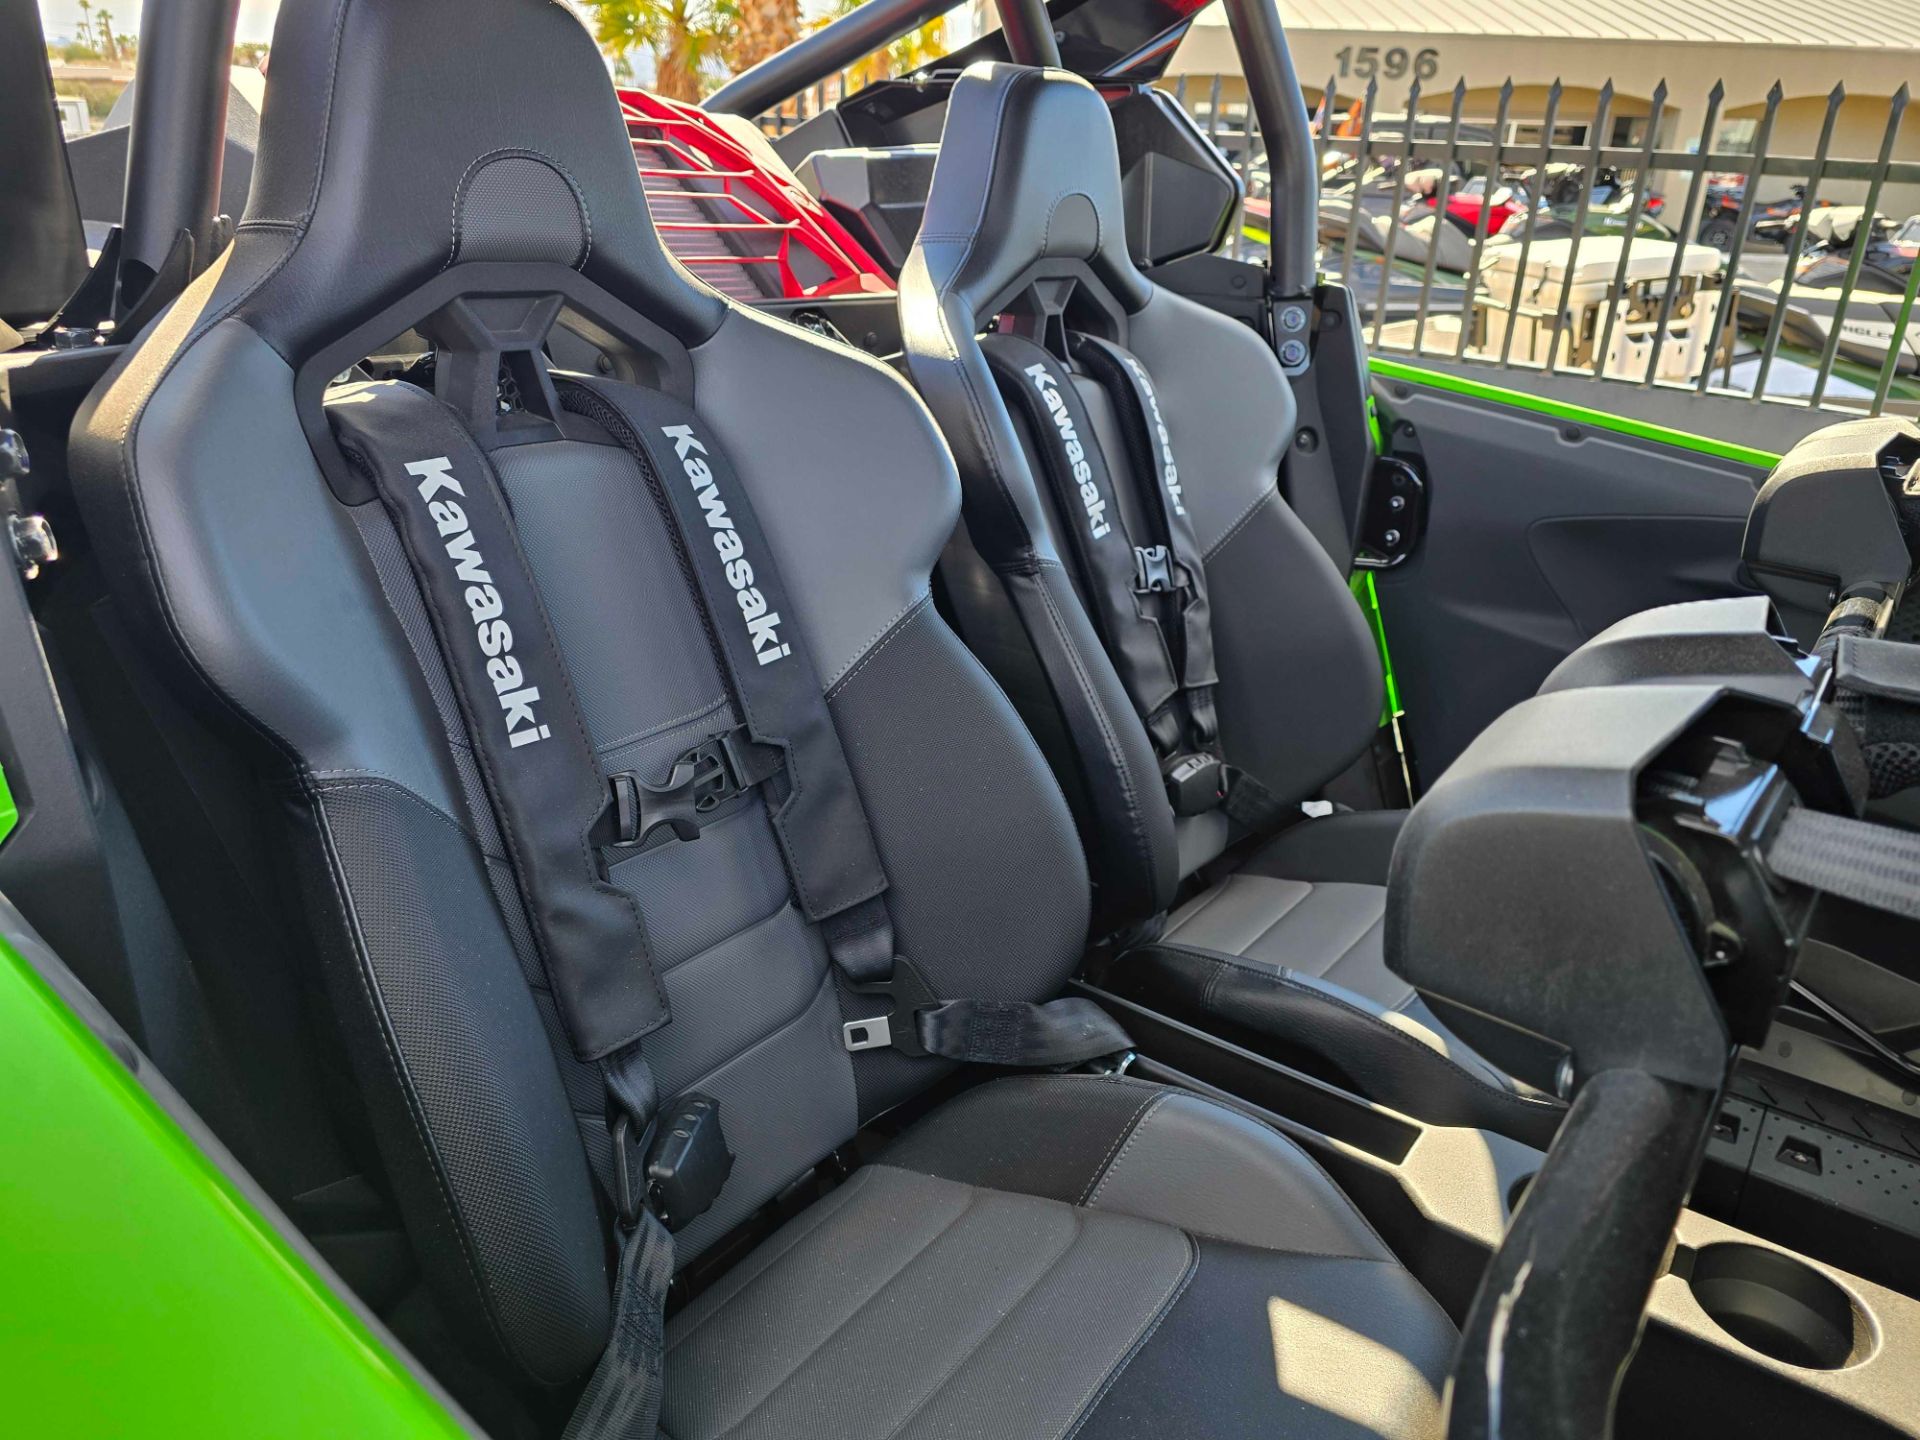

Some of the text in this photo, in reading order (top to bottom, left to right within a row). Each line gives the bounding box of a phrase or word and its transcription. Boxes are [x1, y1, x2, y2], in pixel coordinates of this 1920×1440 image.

[1336, 46, 1440, 79] 1596
[1024, 362, 1111, 540] Kawasaki
[1124, 358, 1186, 516] Kawasaki
[404, 457, 551, 748] Kawasaki
[661, 425, 791, 666] Kawasaki
